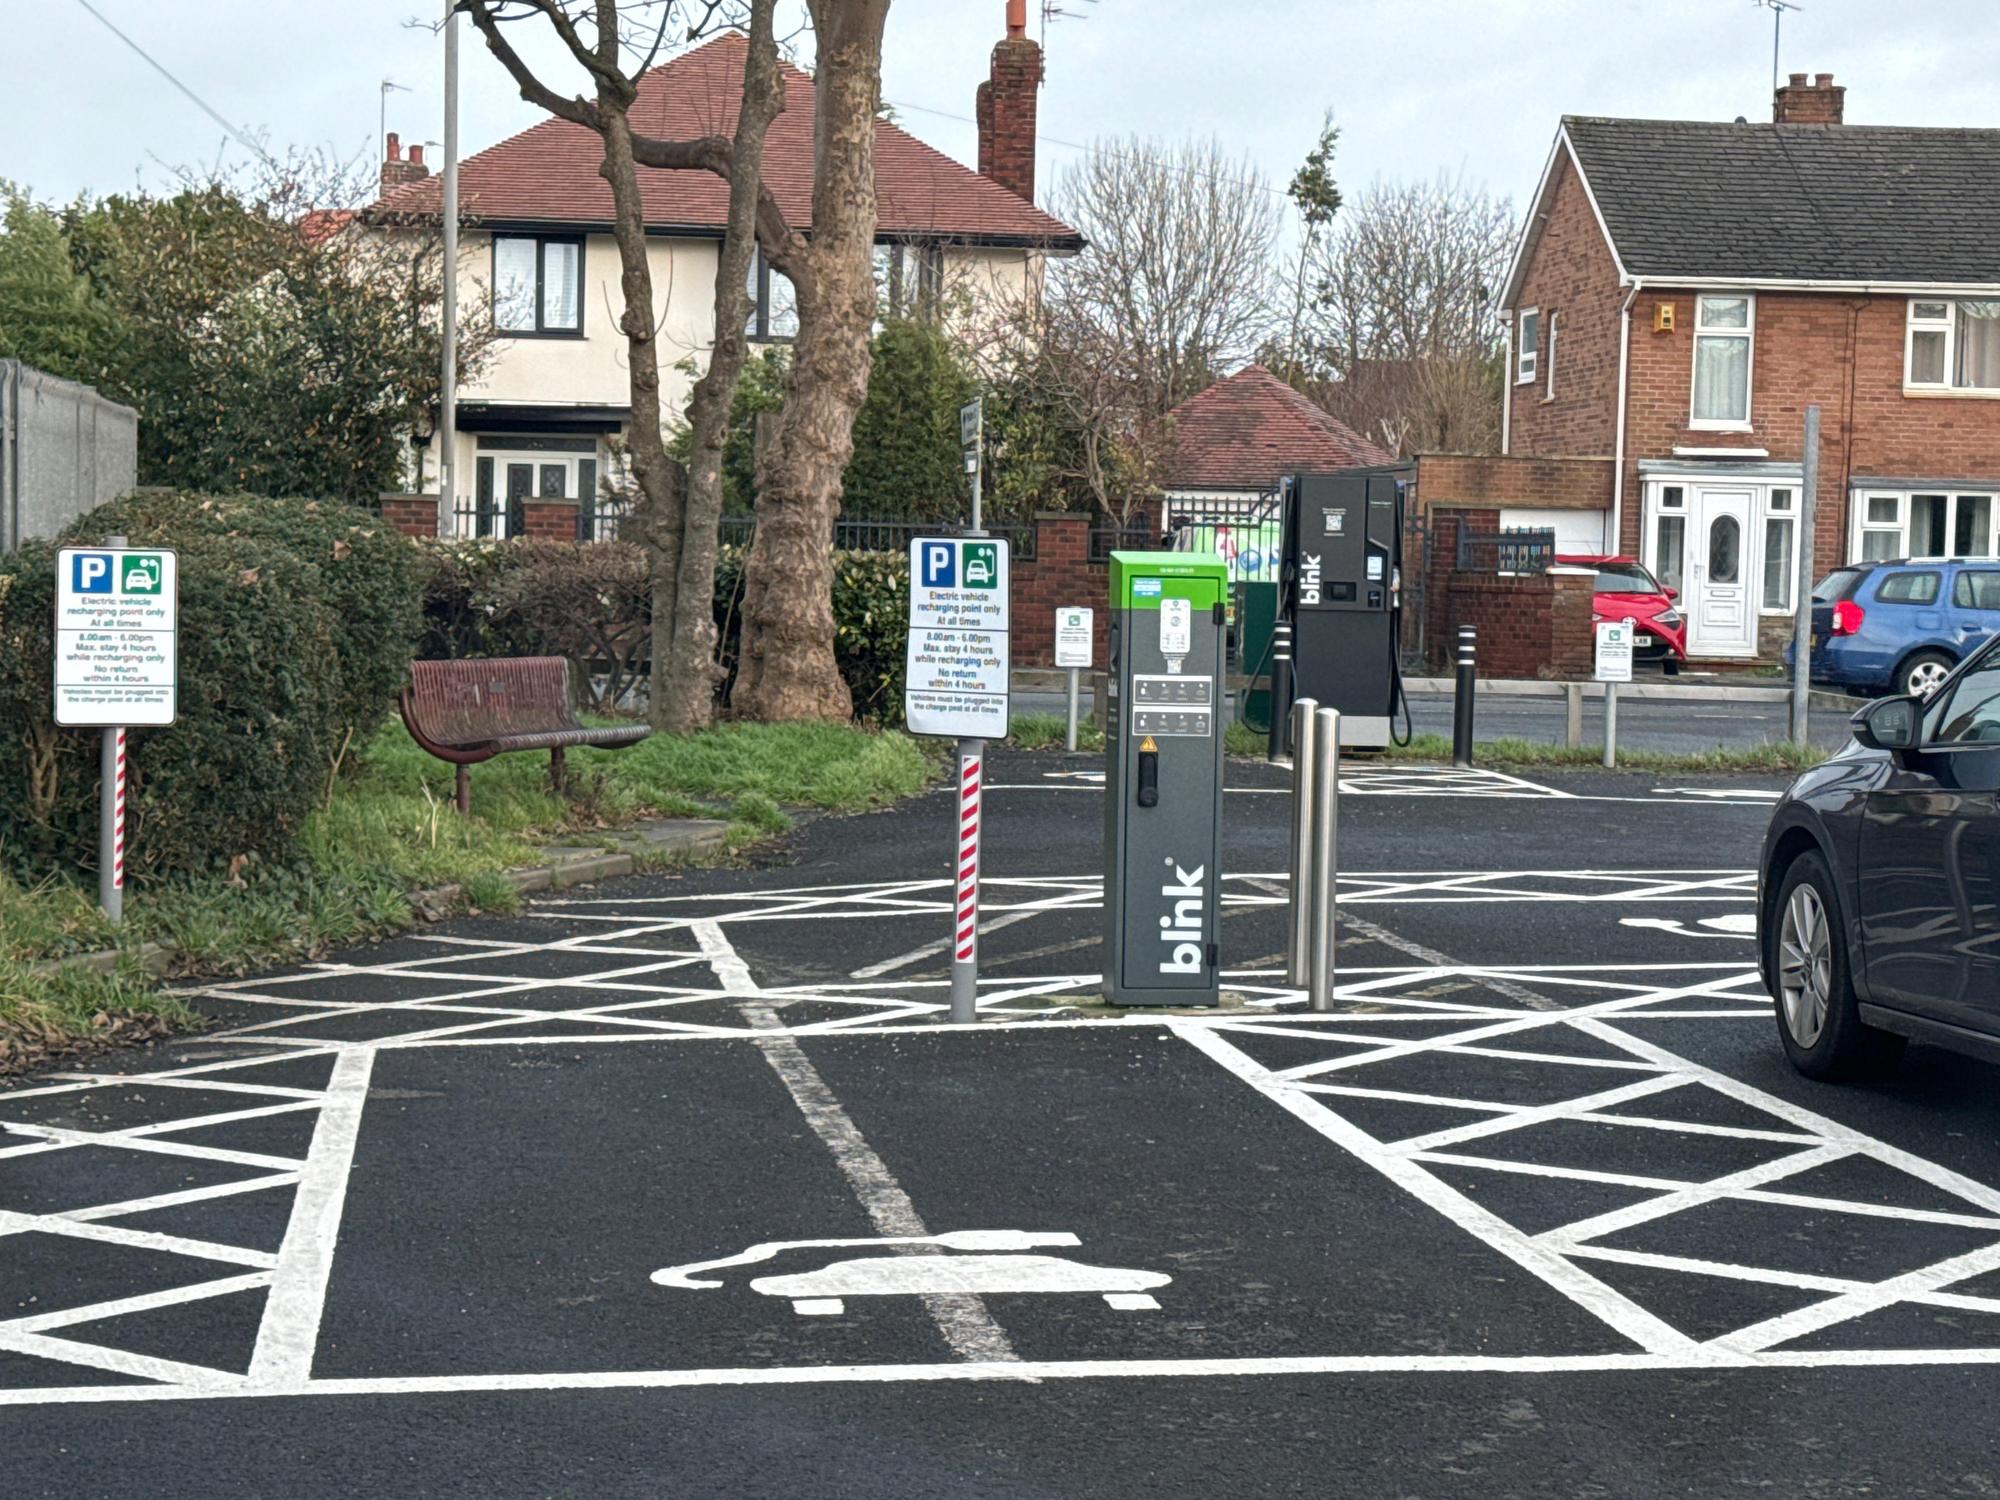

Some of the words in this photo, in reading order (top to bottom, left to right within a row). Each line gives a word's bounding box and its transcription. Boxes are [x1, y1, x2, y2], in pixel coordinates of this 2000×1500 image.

[930, 547, 949, 581] P
[82, 558, 105, 588] P
[1300, 554, 1321, 605] blink
[82, 597, 116, 605] Electric
[930, 592, 959, 601] Electric
[961, 592, 989, 601] vehicle
[67, 608, 117, 616] recharging
[146, 608, 165, 617] only
[918, 603, 959, 614] recharging
[962, 604, 981, 614] point
[984, 605, 1000, 615] only
[948, 617, 957, 625] all
[959, 617, 980, 626] times
[100, 644, 118, 652] stay
[923, 644, 941, 652] Max.
[944, 645, 961, 654] stay
[963, 645, 968, 653] 4
[970, 646, 993, 654] hours
[93, 654, 143, 663] recharging
[146, 655, 165, 663] only
[915, 655, 936, 663] while
[938, 656, 981, 667] recharging
[984, 658, 1000, 668] only
[938, 668, 949, 676] No
[952, 669, 976, 678] return
[929, 679, 952, 687] within
[962, 681, 985, 689] hours
[1160, 864, 1204, 973] blink
